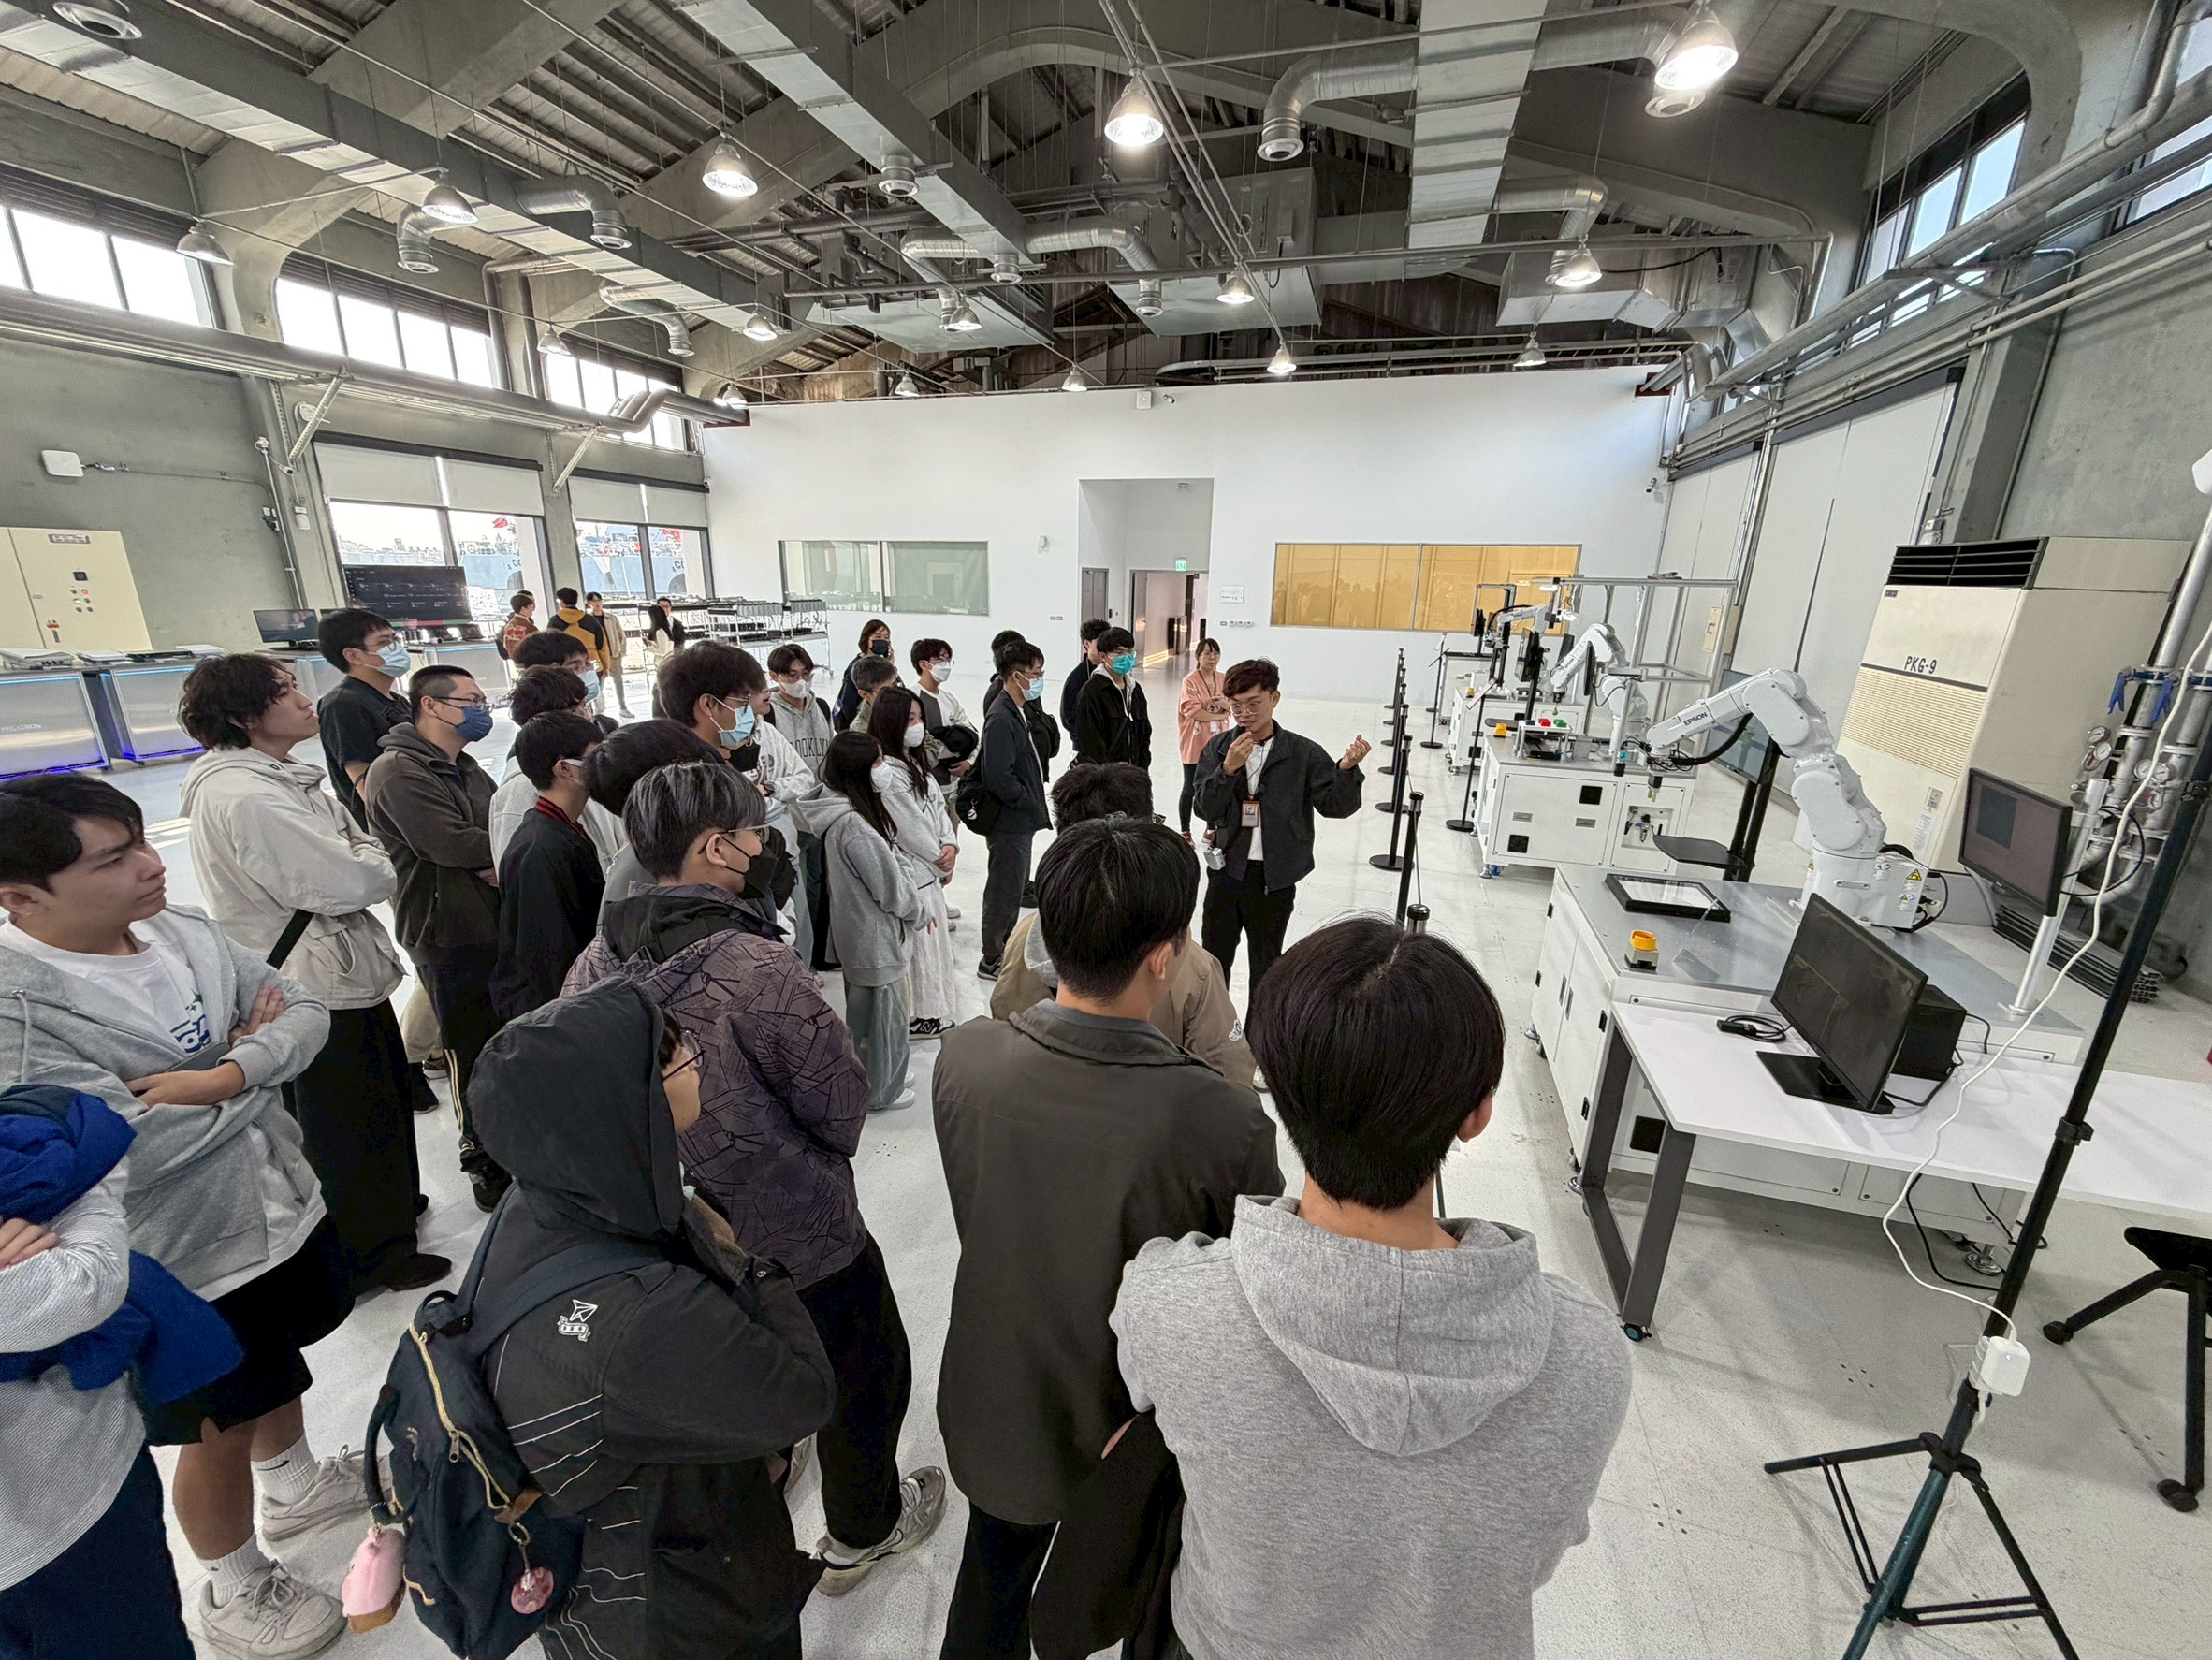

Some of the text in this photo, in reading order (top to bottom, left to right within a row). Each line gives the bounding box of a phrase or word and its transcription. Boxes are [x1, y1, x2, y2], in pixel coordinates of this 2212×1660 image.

[1904, 655, 1938, 674] PKG-9
[1683, 711, 1708, 726] EPSON
[789, 737, 829, 758] OOKLY
